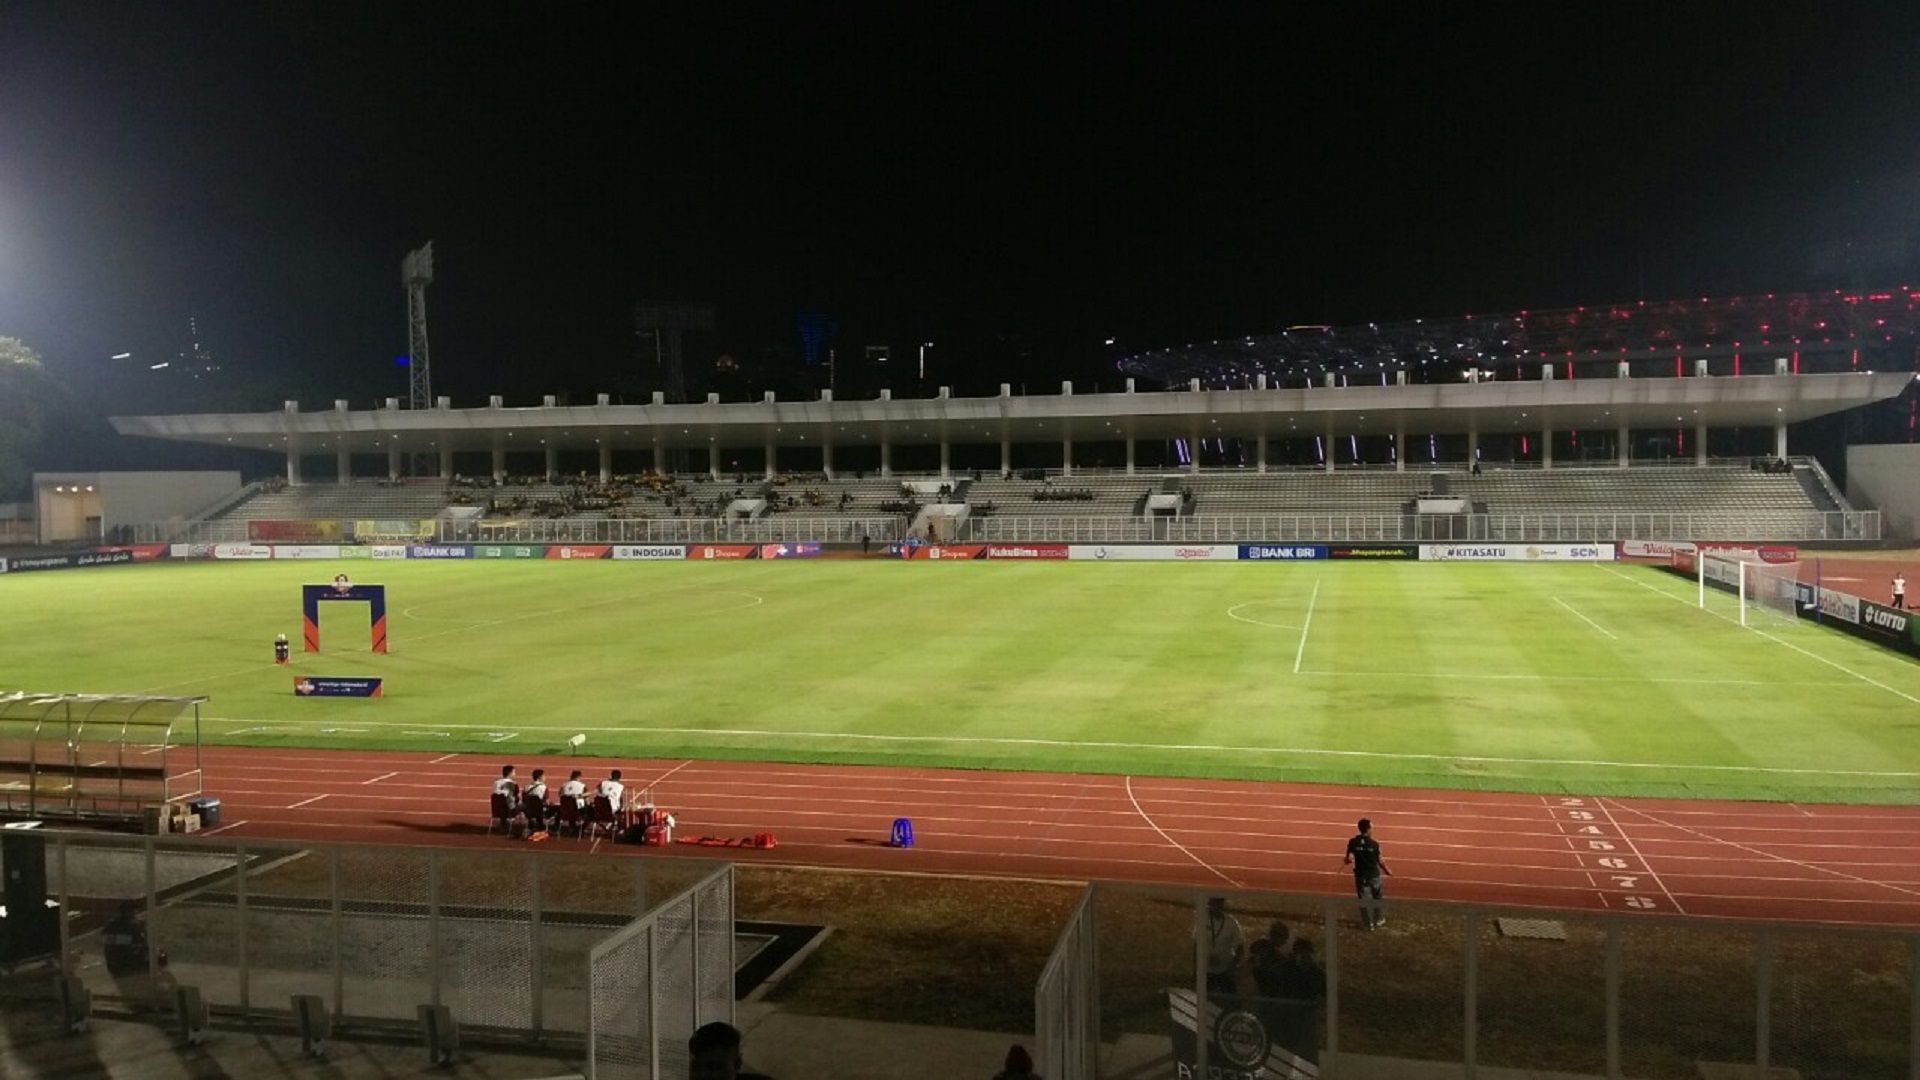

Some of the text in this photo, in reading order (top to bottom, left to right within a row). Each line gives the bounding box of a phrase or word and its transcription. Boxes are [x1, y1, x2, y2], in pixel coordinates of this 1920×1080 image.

[632, 548, 682, 557] INDOSIAR
[1261, 548, 1315, 558] BANK BRI
[1570, 548, 1598, 557] SCM
[1874, 609, 1906, 631] LOTTO
[1568, 810, 1595, 821] 3
[1589, 840, 1616, 851] 5
[1598, 857, 1629, 869] 6
[1610, 875, 1639, 888] 7
[1624, 896, 1657, 909] 8
